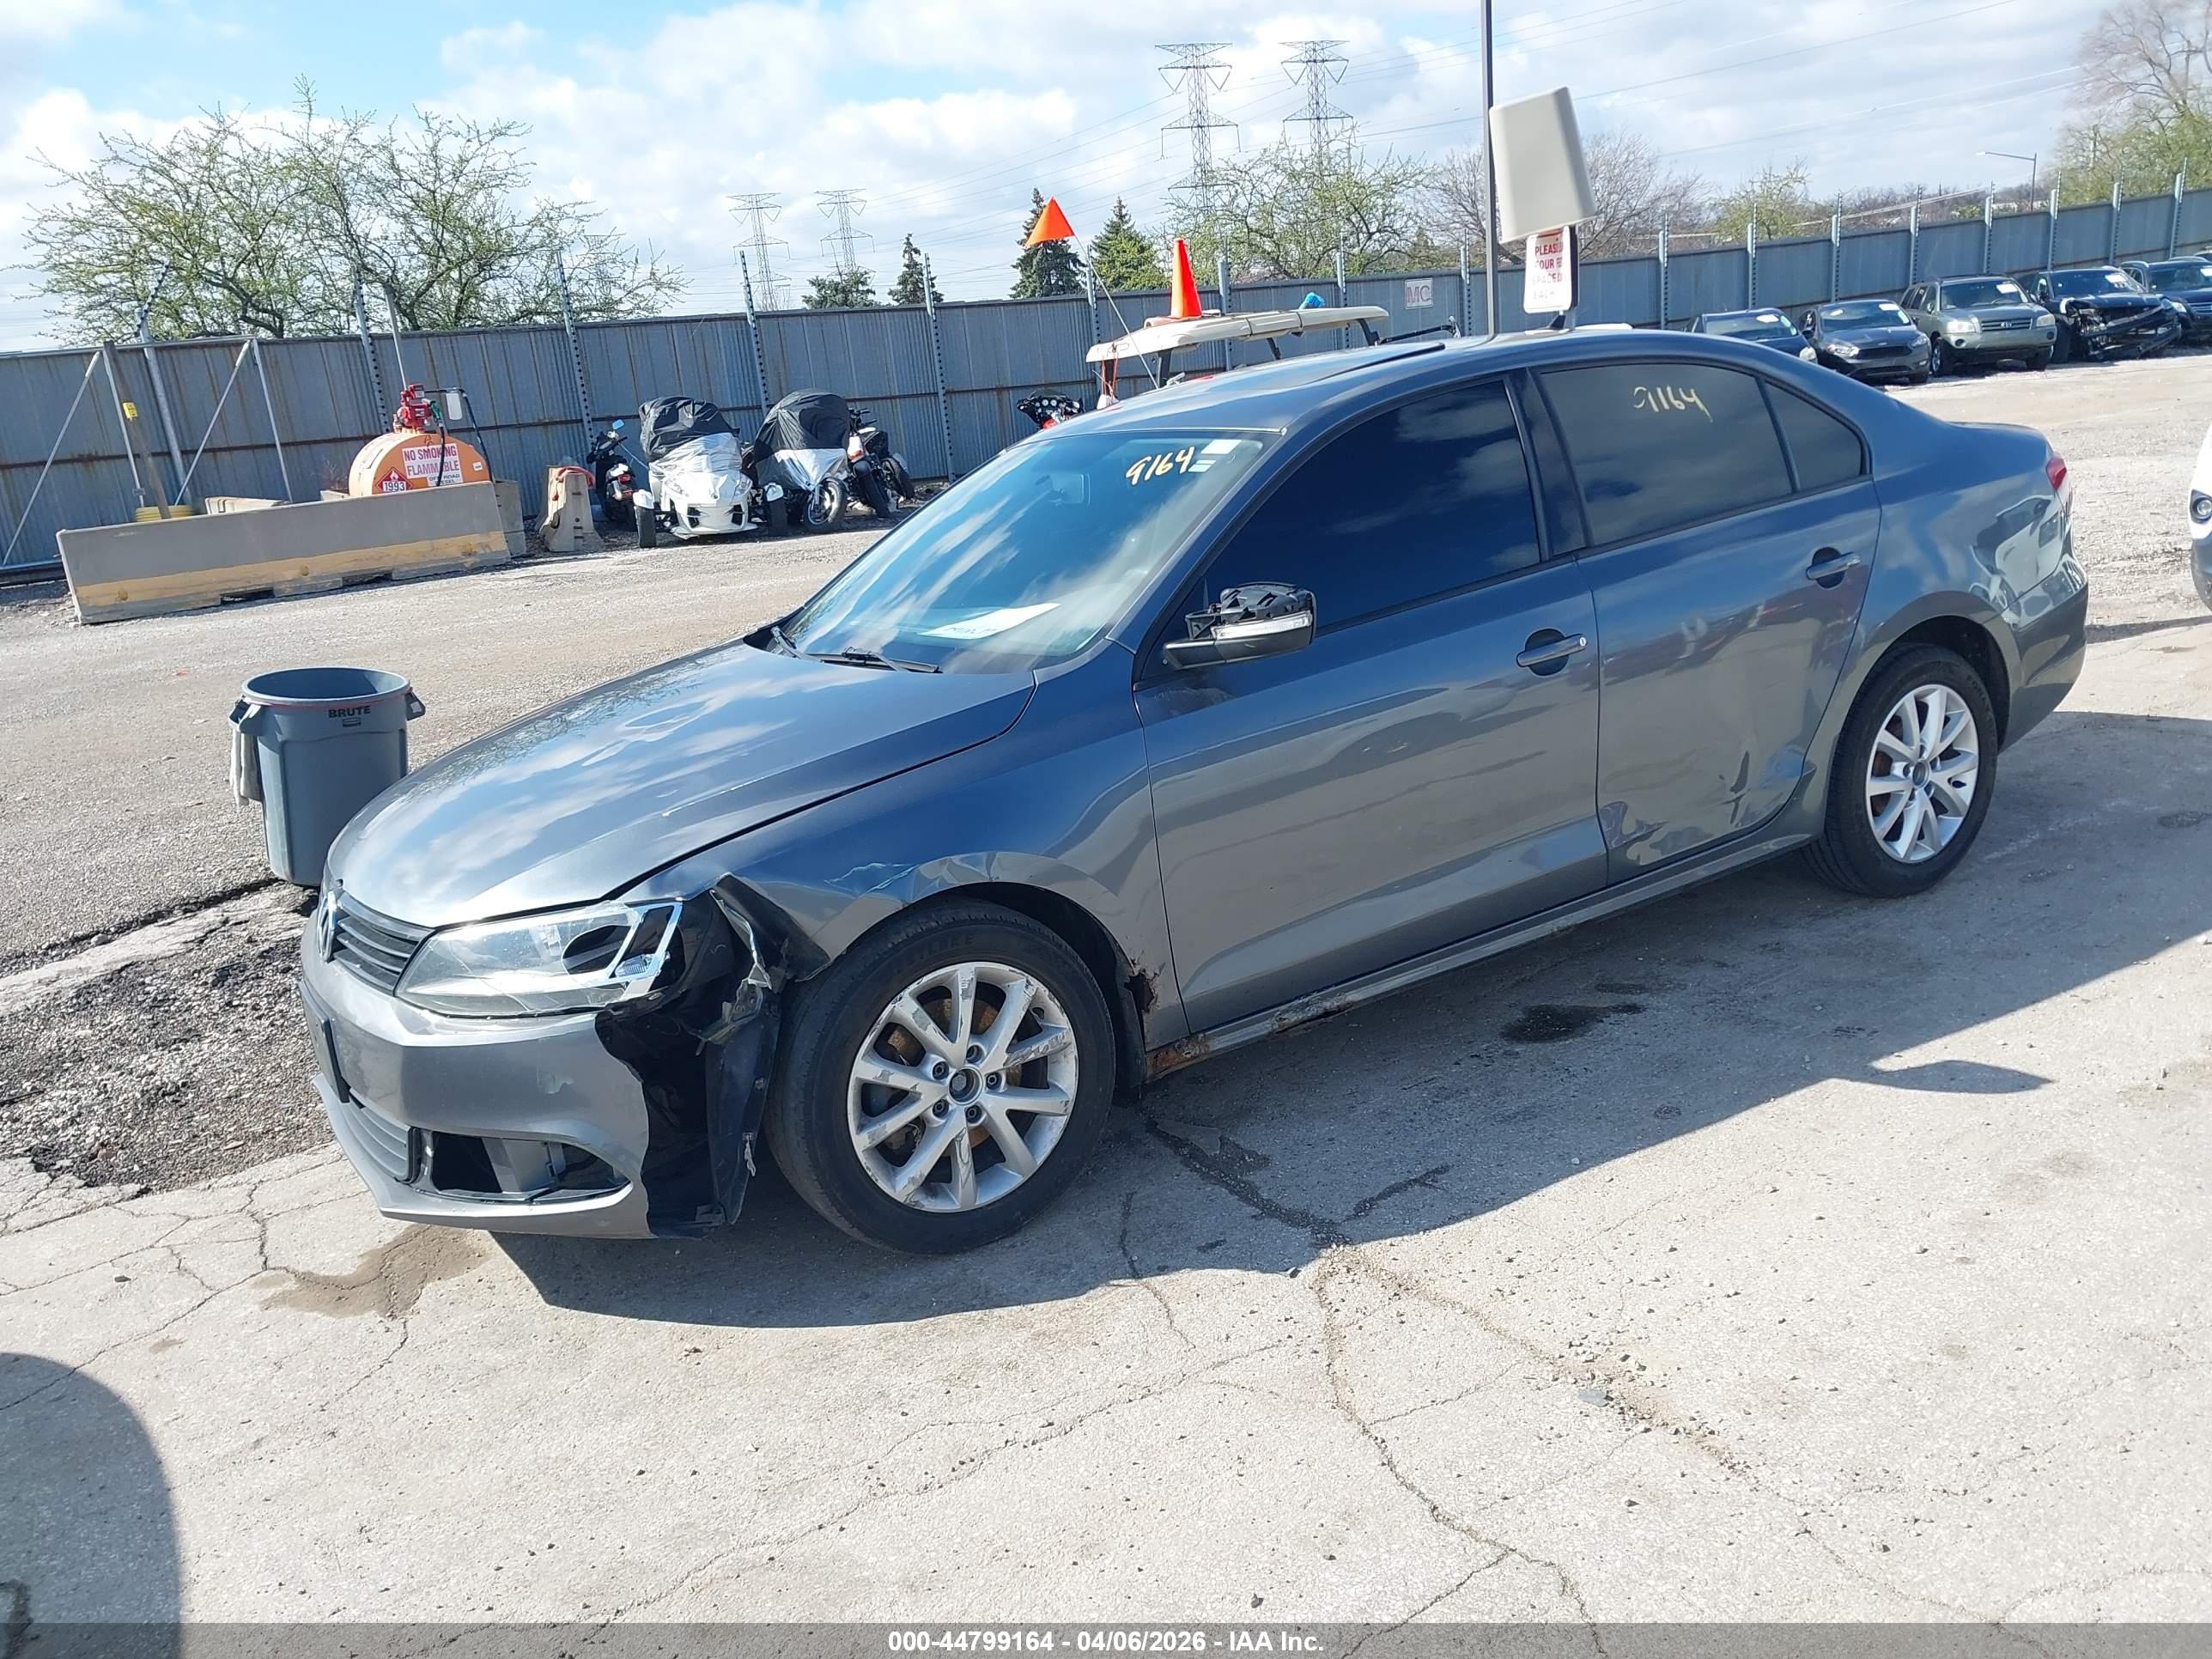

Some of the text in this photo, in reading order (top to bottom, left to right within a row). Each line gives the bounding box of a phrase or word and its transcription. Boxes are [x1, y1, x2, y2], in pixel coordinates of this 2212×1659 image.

[1407, 285, 1432, 303] MC
[404, 446, 457, 461] NO SMOKNG
[406, 459, 460, 477] FLAMMBLE
[1126, 446, 1195, 486] 9164
[384, 482, 405, 492] 1993
[329, 705, 371, 718] BRUTE
